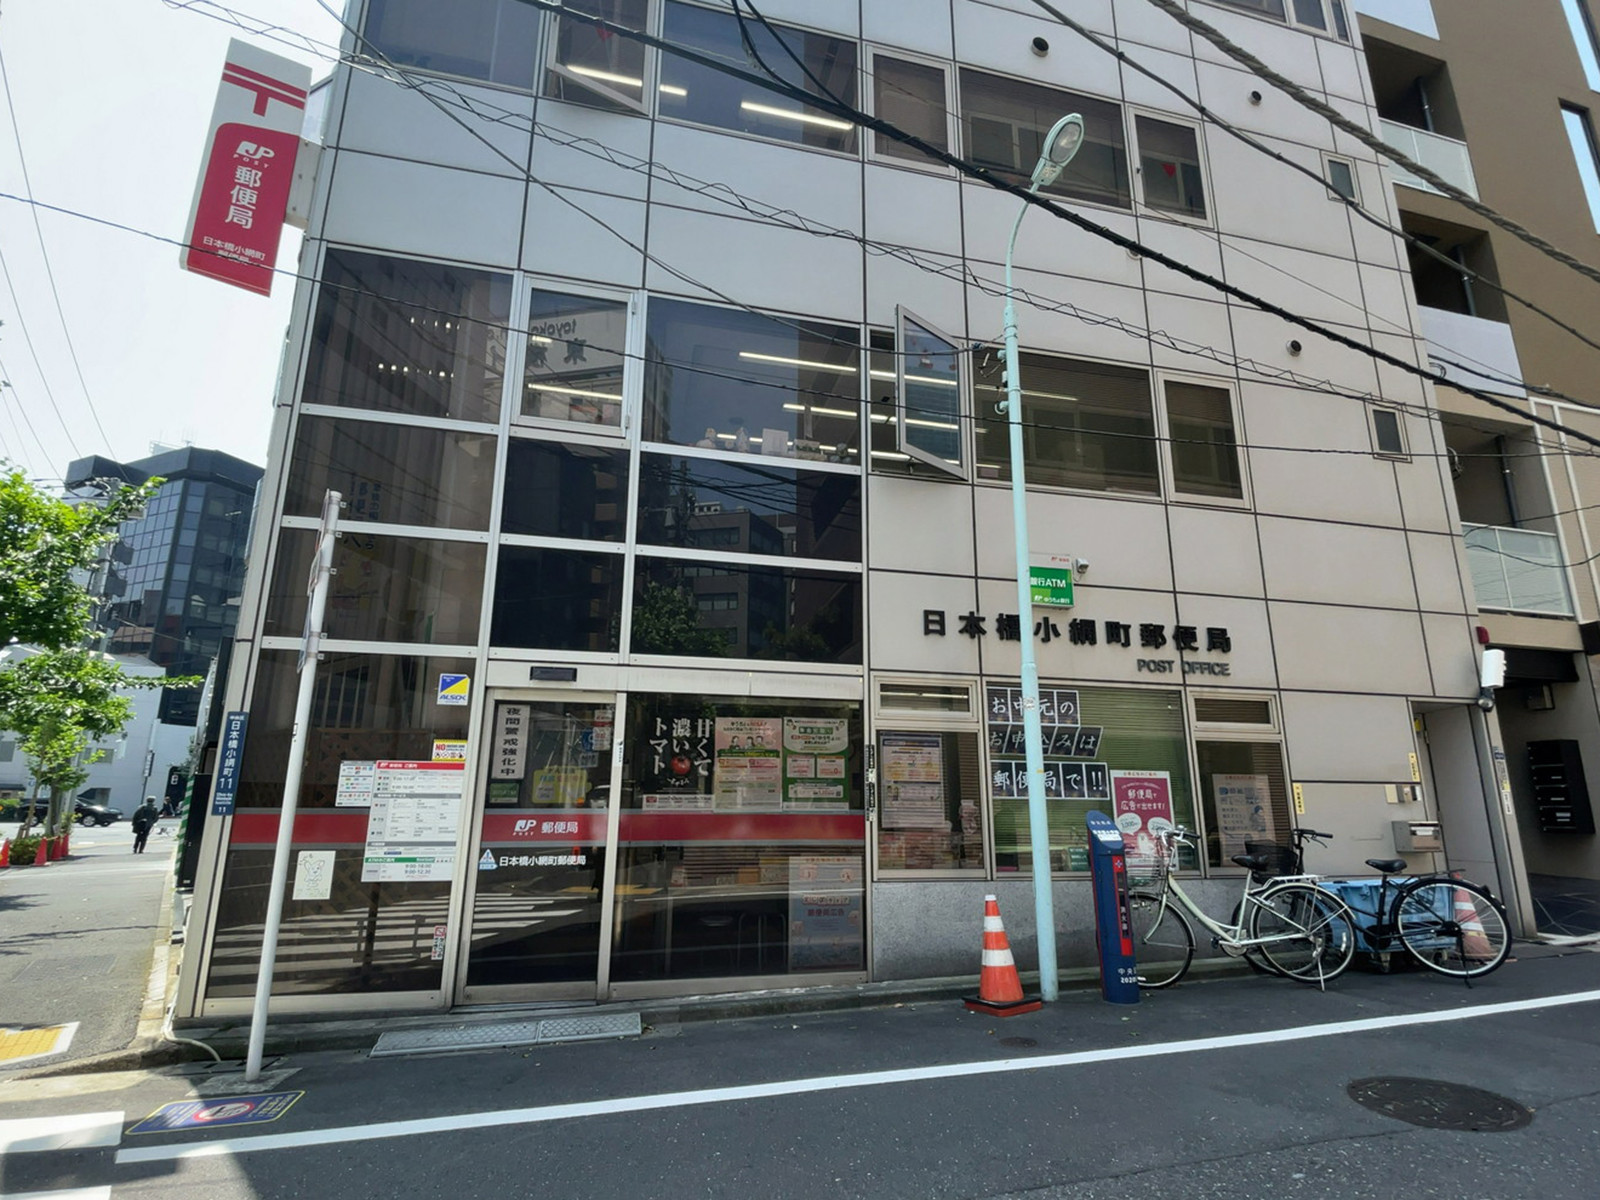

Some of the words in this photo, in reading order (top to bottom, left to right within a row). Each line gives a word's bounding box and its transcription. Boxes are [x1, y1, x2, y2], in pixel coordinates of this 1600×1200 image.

[233, 154, 270, 169] POST
[225, 165, 262, 229] 郵便局
[203, 236, 265, 261] 日本橋小網町
[923, 610, 1231, 654] 日本橋小網町郵便局
[1137, 659, 1175, 673] POST
[1182, 661, 1231, 676] OFFICE
[435, 743, 446, 751] NO
[500, 707, 522, 776] 夜間警戒強化中
[649, 717, 668, 775] トマト
[672, 718, 691, 753] 濃い
[694, 718, 713, 776] 甘くて
[219, 777, 233, 789] 11
[541, 821, 579, 834] 郵便局
[499, 856, 587, 867] 日本橋小網町郵便局
